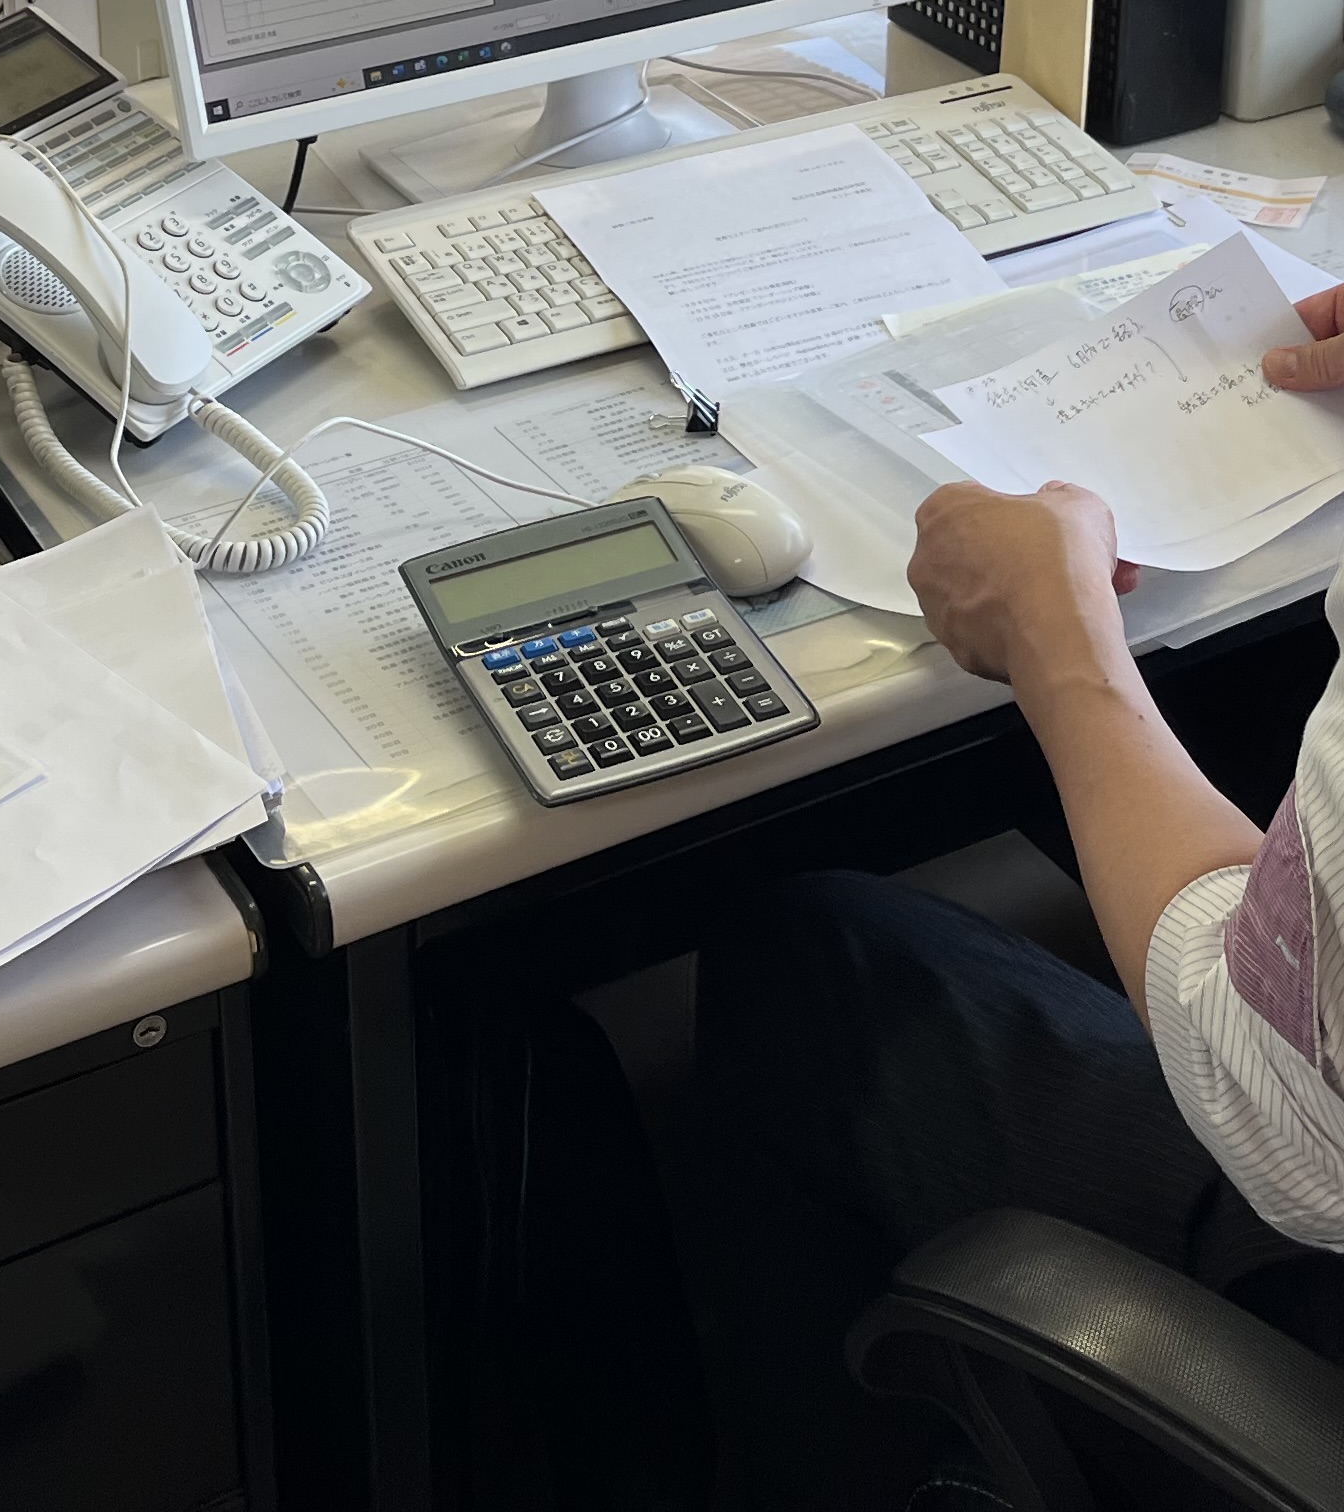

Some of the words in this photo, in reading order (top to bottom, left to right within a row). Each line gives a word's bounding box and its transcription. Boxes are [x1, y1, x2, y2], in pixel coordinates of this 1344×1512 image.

[971, 101, 1006, 113] FUJITSU
[146, 232, 155, 241] 2
[170, 218, 179, 227] 3
[172, 253, 182, 262] 5
[194, 239, 205, 247] 6
[197, 274, 207, 284] 8
[222, 260, 232, 268] 9
[223, 297, 234, 306] 0
[719, 481, 748, 502] FUJITSU
[425, 551, 487, 575] Canon
[702, 628, 721, 640] GT
[554, 672, 564, 682] 7
[594, 661, 606, 670] 8
[630, 650, 642, 660] 9
[512, 684, 534, 694] CA
[572, 695, 583, 704] 4
[610, 682, 622, 692] 5
[649, 672, 660, 682] 6
[588, 718, 598, 728] 1
[626, 706, 638, 716] 2
[665, 696, 676, 706] 3
[604, 740, 618, 750] 0
[638, 728, 661, 741] 00
